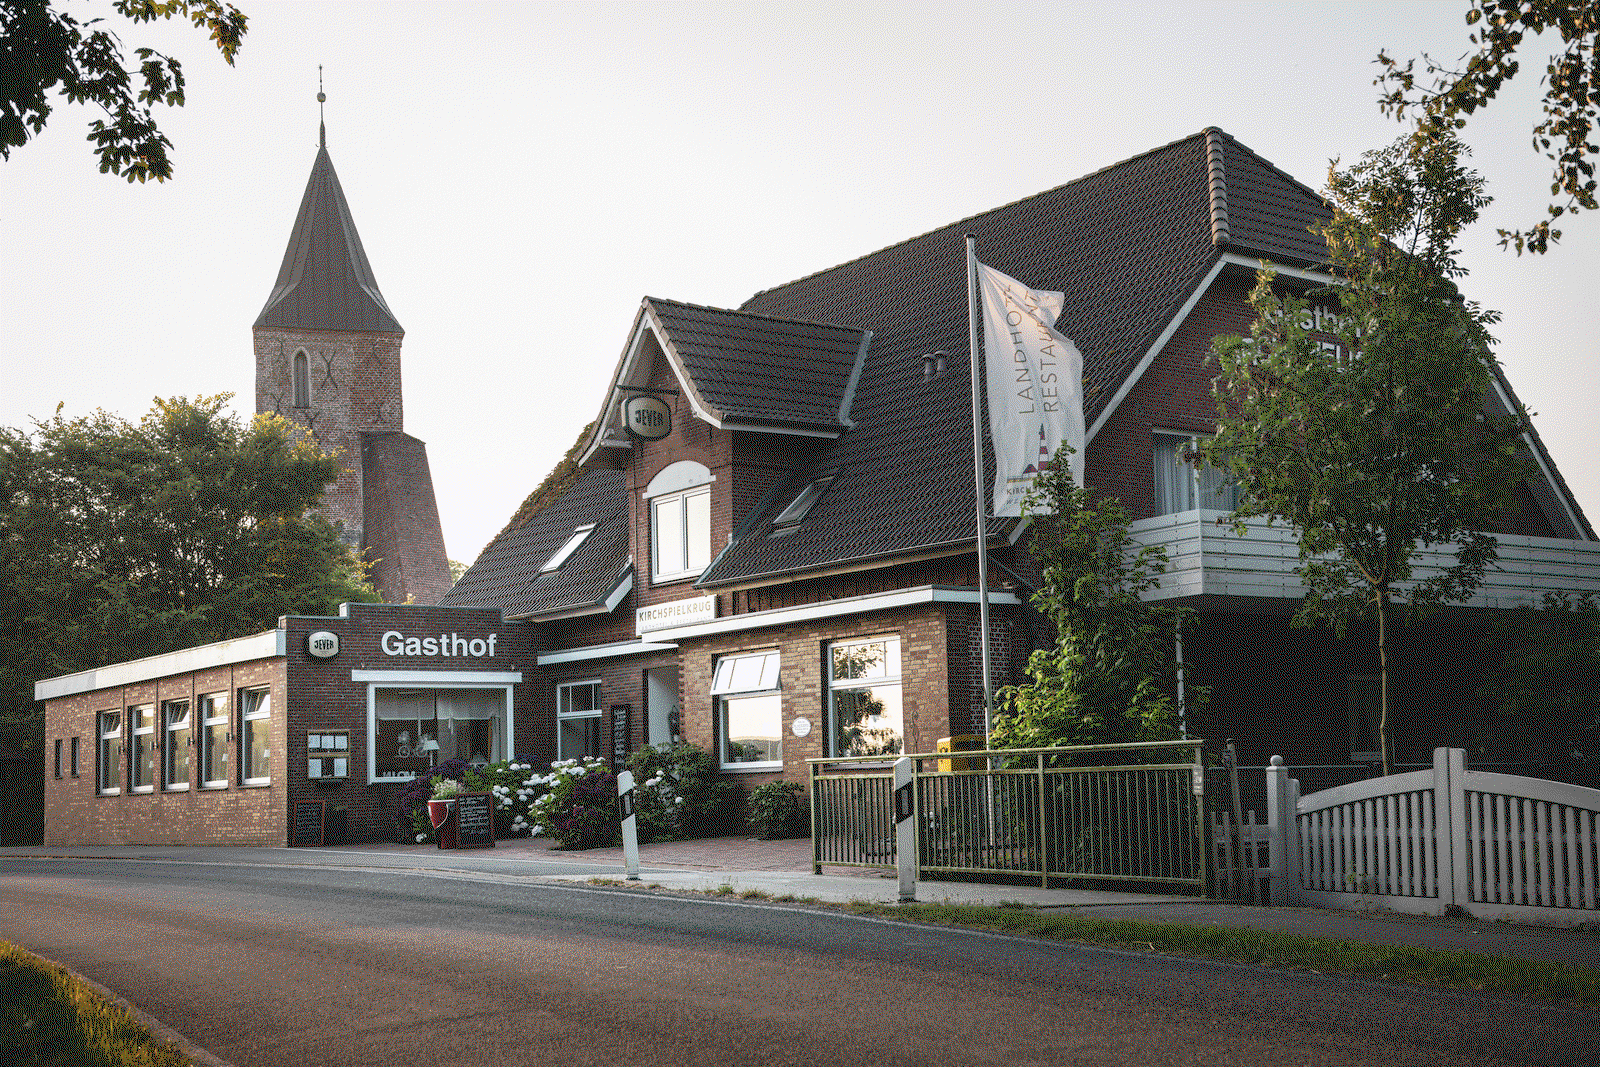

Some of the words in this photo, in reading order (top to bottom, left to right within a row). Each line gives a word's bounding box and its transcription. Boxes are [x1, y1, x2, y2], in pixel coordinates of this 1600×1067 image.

[1025, 290, 1059, 412] RESTAUNT
[639, 601, 711, 622] KIRCHSPIELKRUG
[314, 639, 335, 650] JEVER
[381, 630, 497, 657] Gasthof
